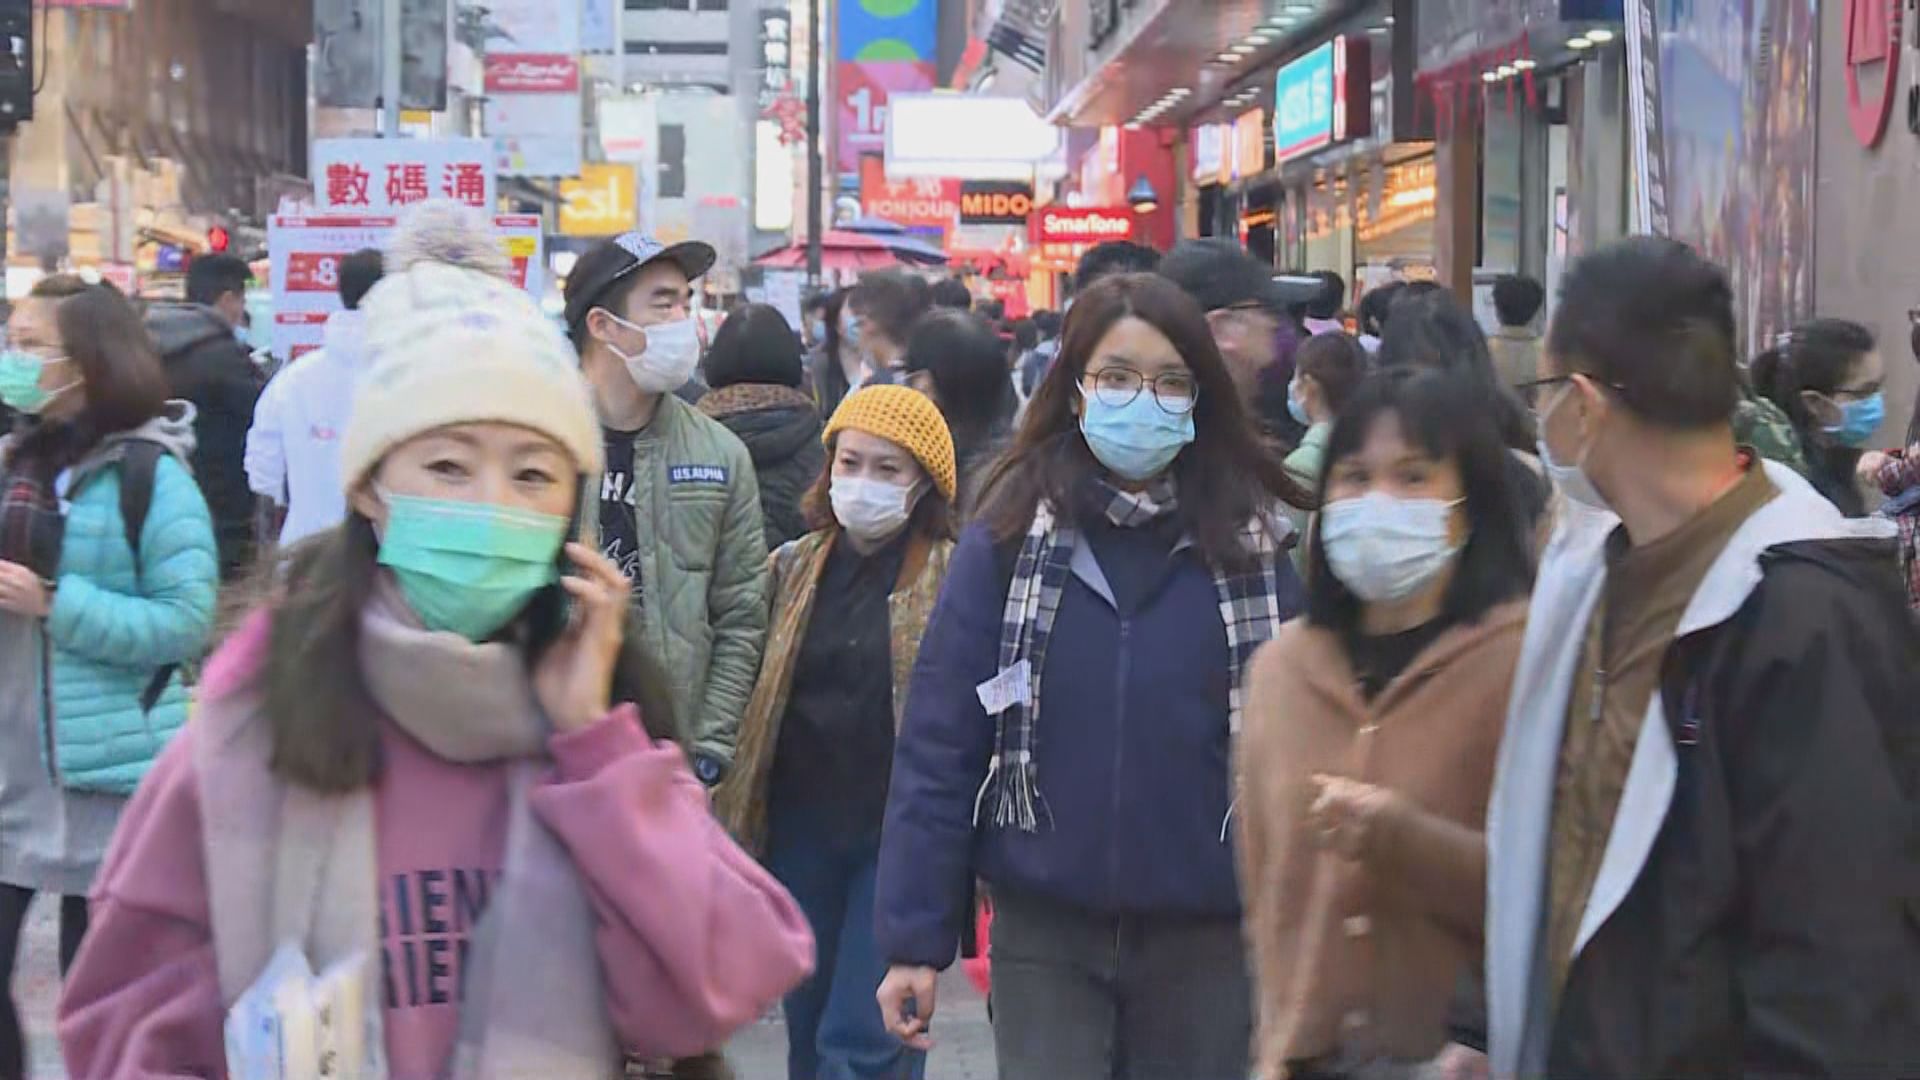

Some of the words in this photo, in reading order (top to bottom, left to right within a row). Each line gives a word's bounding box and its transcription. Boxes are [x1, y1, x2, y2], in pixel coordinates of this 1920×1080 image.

[326, 162, 485, 207] 數碼通
[961, 193, 1030, 216] MIDO
